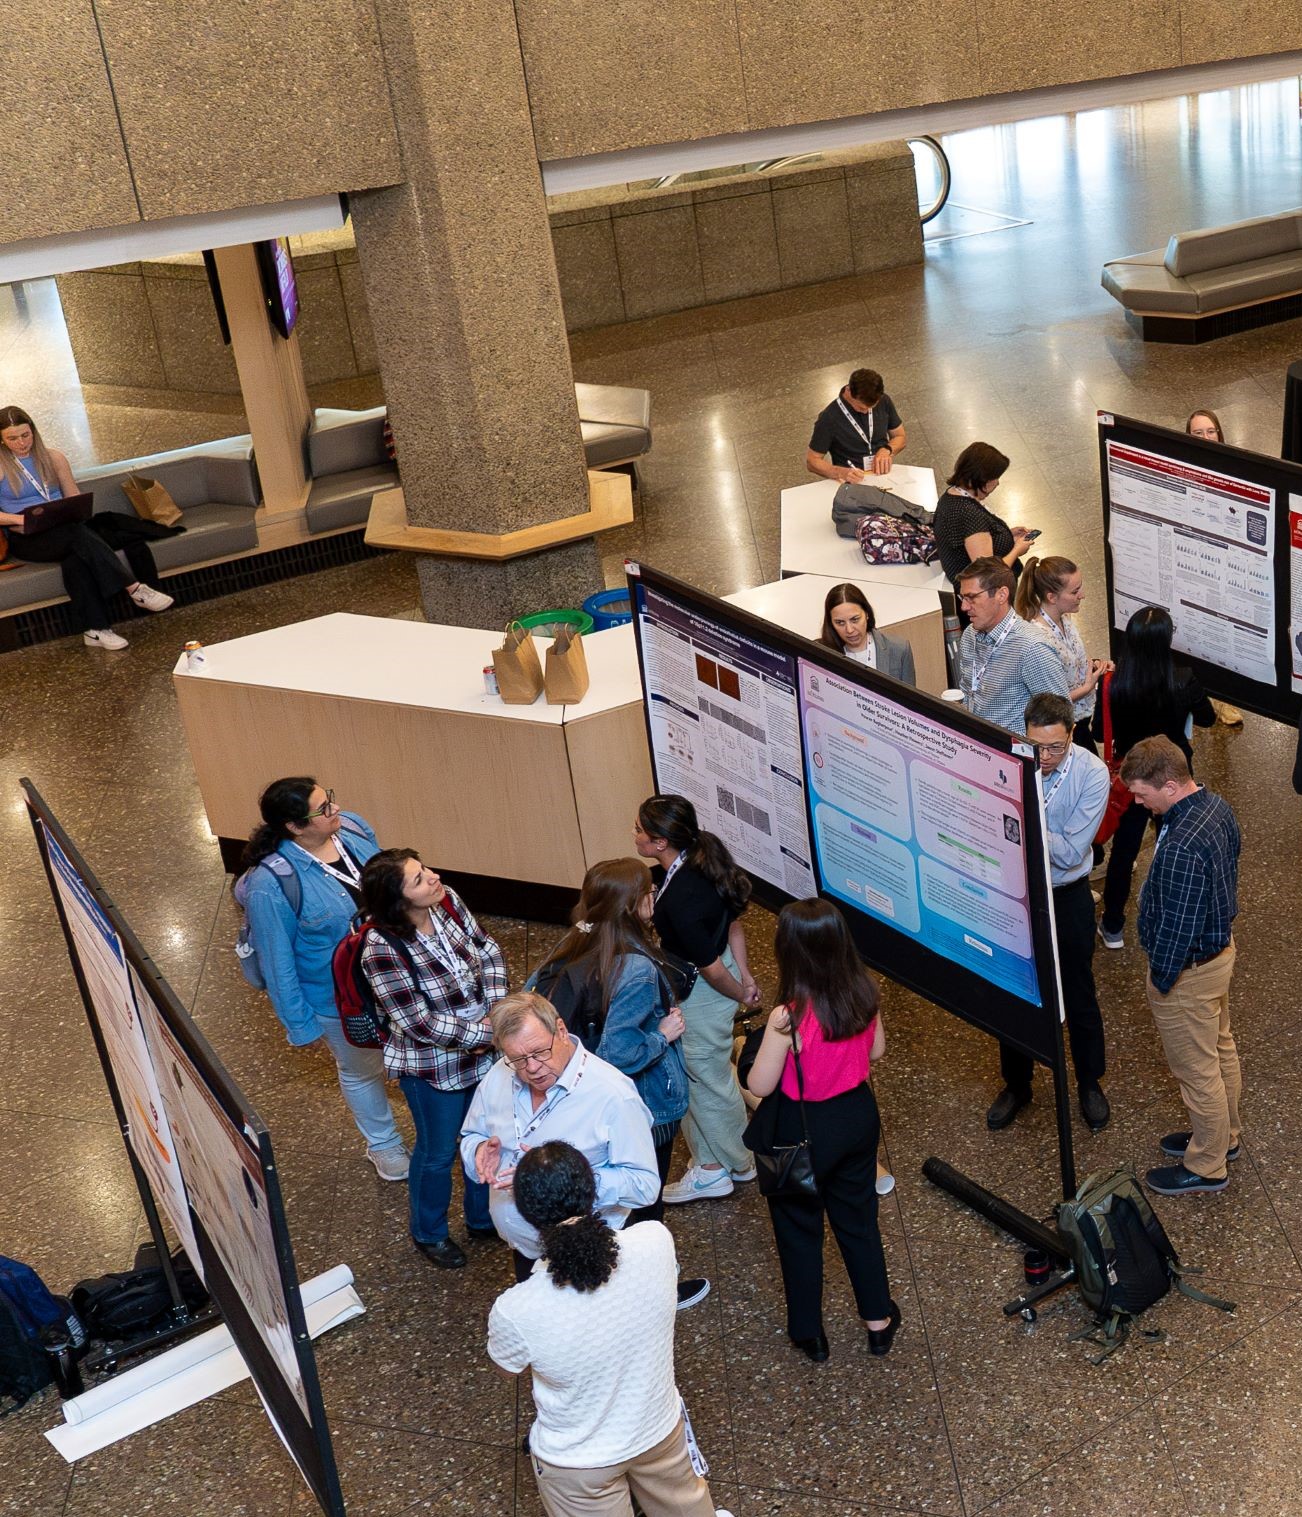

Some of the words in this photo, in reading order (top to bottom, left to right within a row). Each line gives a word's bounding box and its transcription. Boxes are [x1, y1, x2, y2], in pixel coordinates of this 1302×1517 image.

[826, 677, 852, 696] Association
[853, 691, 874, 707] Between
[874, 700, 891, 714] Stroke
[891, 708, 907, 722] Lesion
[908, 715, 930, 732] Volumes
[930, 727, 941, 737] and
[941, 730, 969, 752] Dysphagia
[969, 744, 991, 762] Severity
[862, 703, 876, 715] Older
[876, 711, 901, 728] Survivors:
[907, 724, 942, 747] Retrospective
[941, 740, 958, 756] Study
